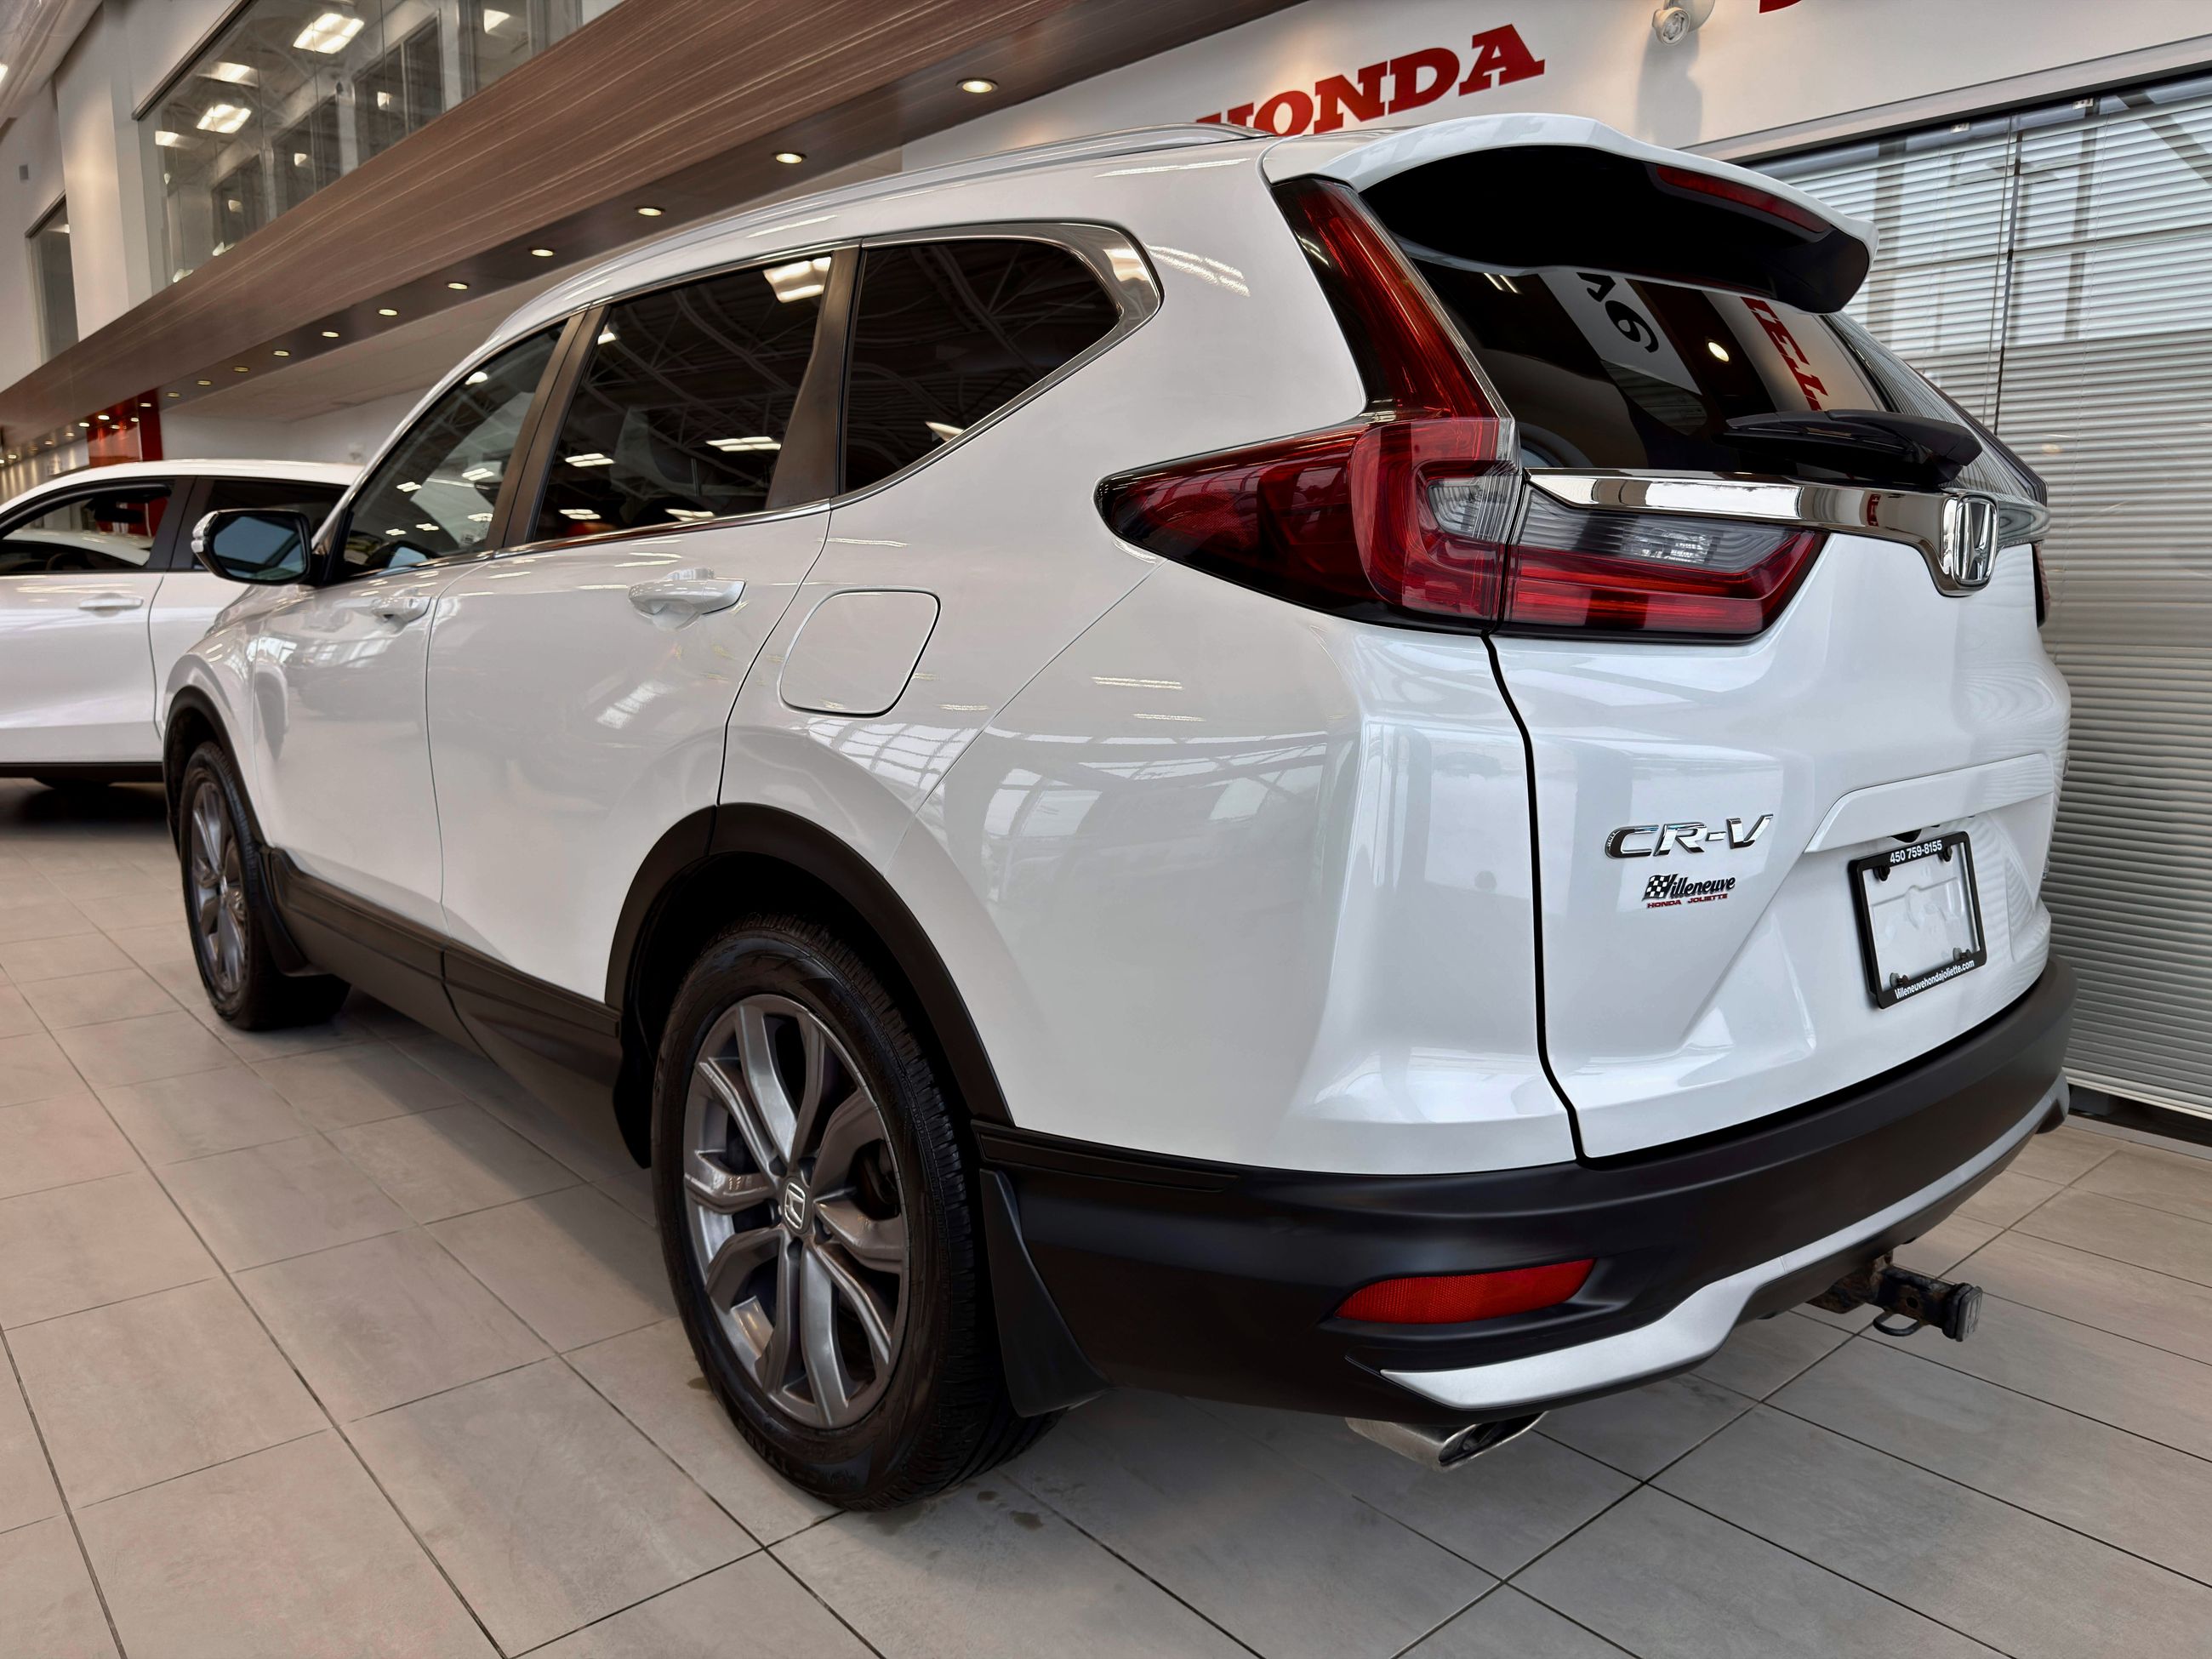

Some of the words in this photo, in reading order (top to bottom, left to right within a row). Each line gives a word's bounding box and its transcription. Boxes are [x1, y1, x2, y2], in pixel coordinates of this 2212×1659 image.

[1605, 813, 1774, 859] CR-V
[1890, 850, 1906, 864] 450
[1907, 840, 1943, 859] 759-8155
[1652, 874, 1736, 900] Villeneuve
[1646, 898, 1682, 909] HONDA
[1687, 892, 1729, 904] JOLIETTE
